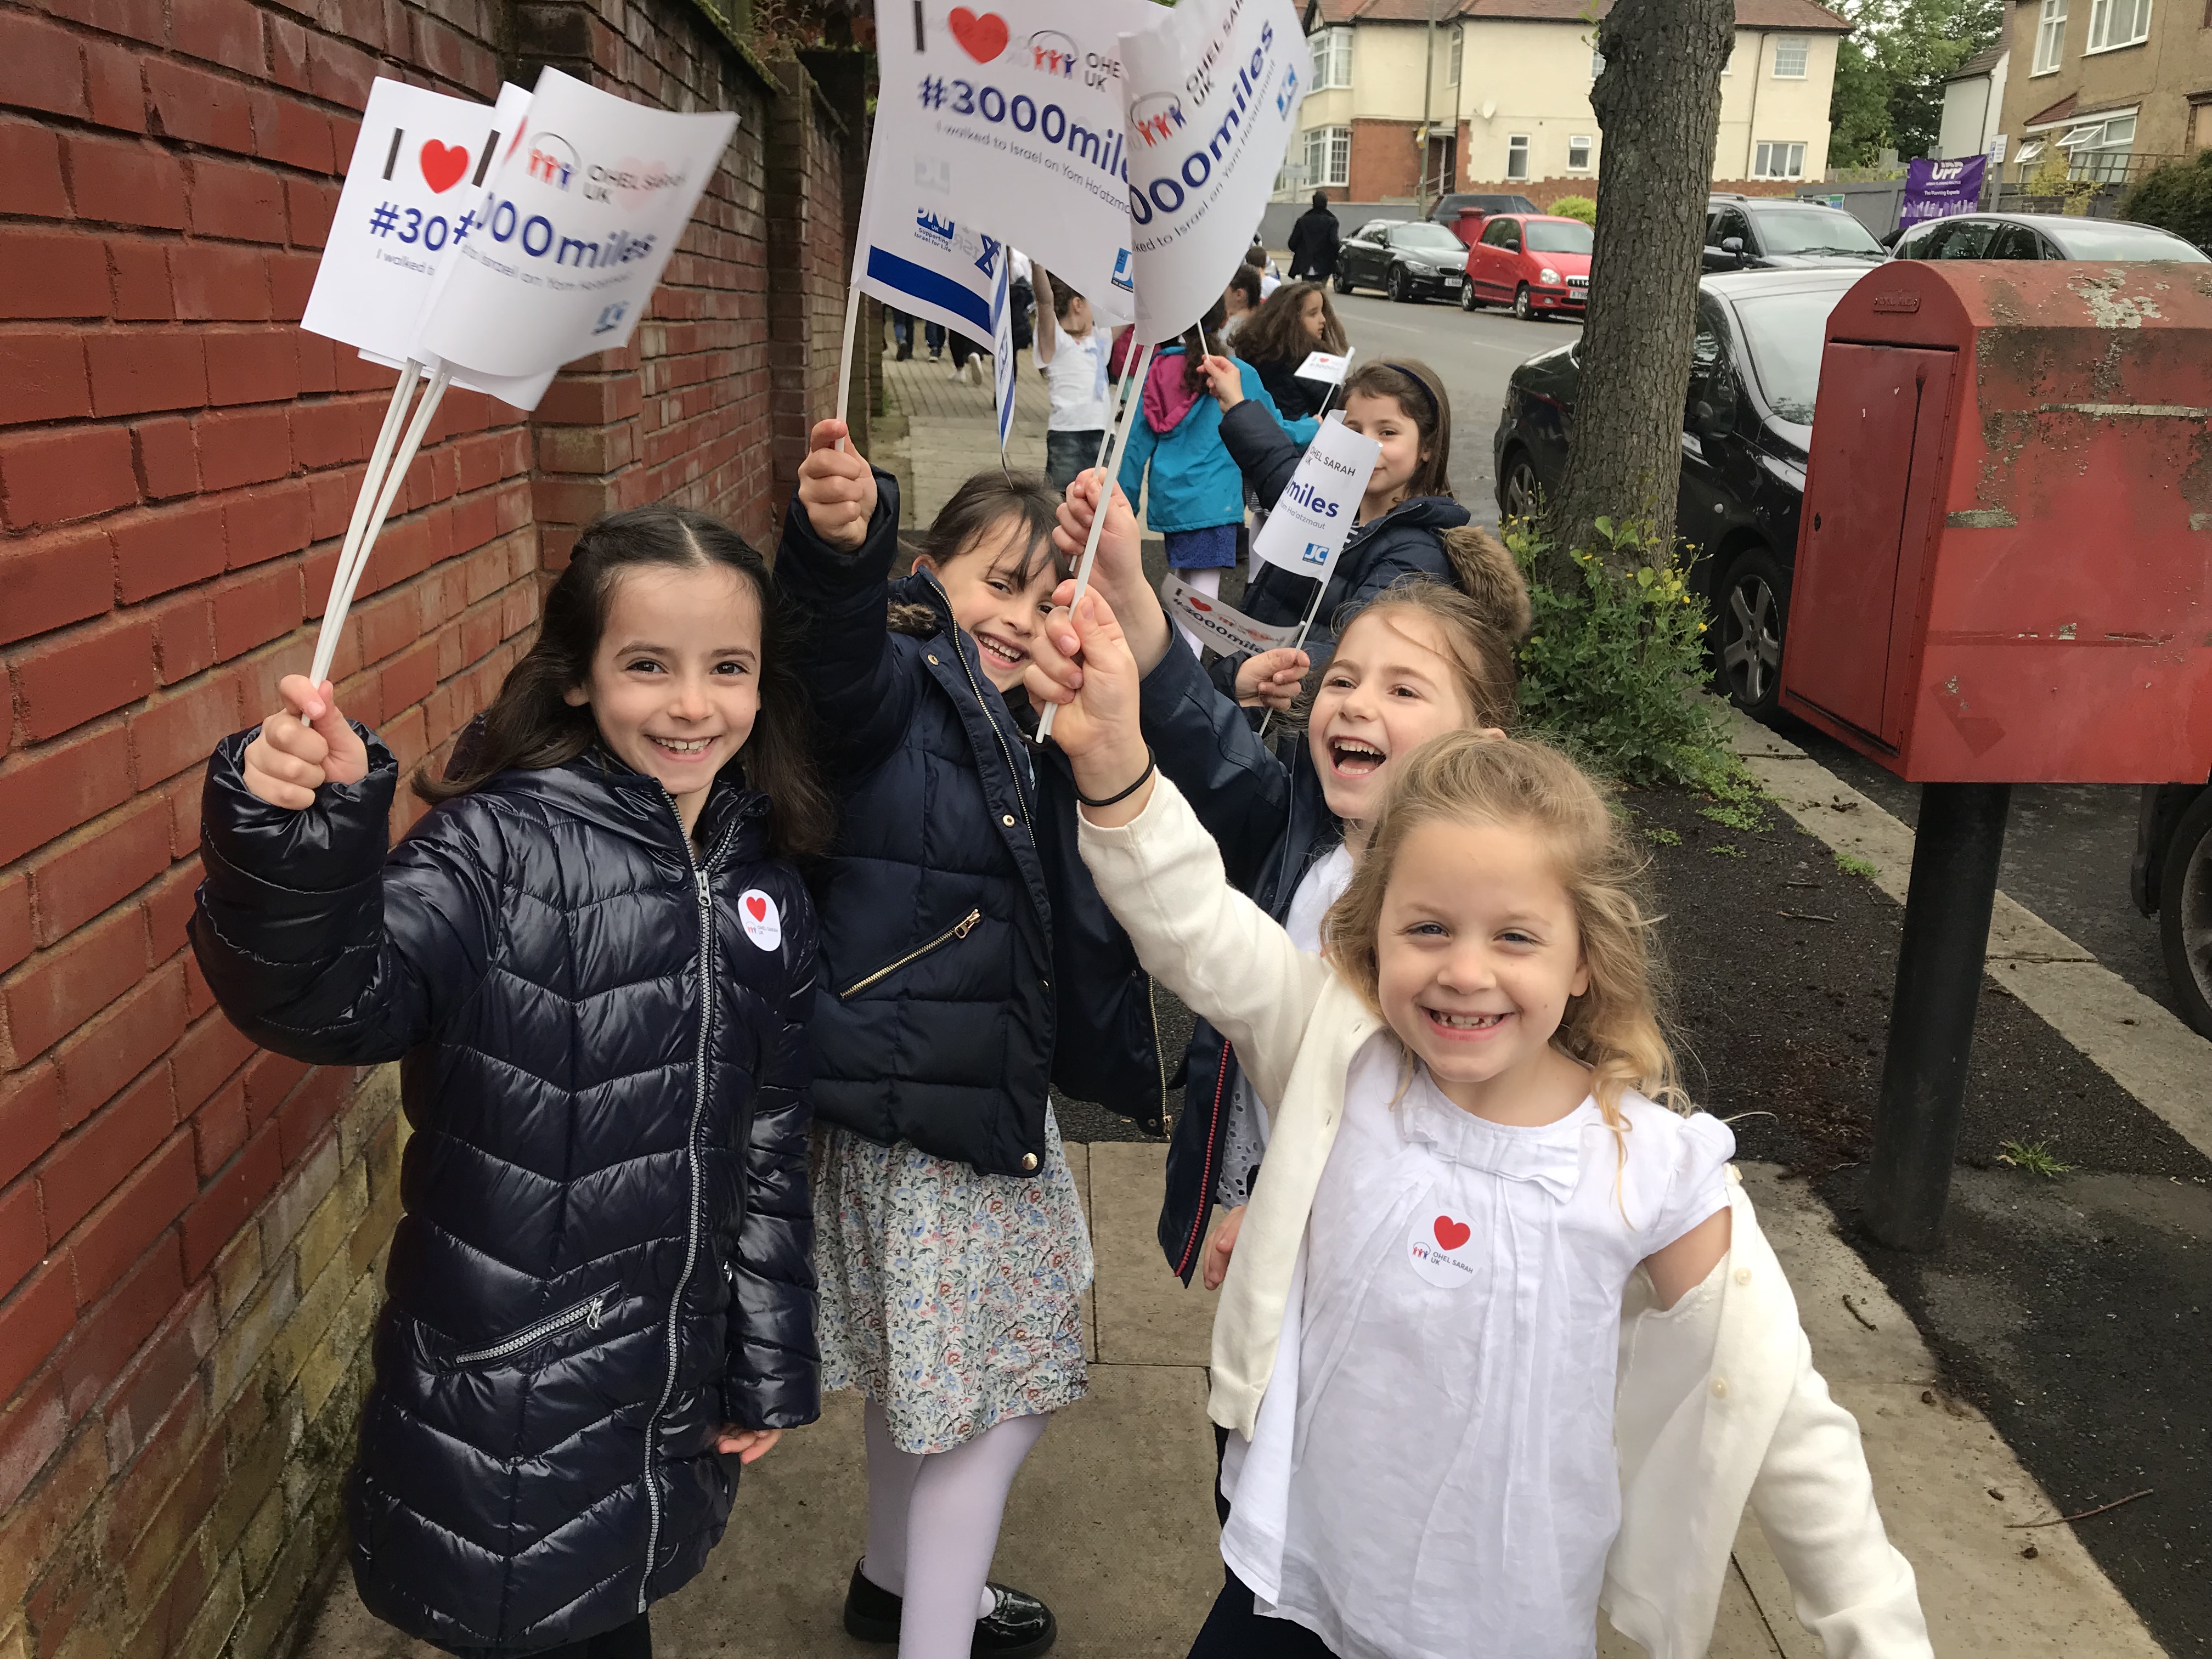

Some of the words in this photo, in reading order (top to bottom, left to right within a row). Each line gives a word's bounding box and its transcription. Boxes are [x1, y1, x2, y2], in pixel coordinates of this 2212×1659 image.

[1186, 39, 1224, 94] OHEL
[1084, 70, 1109, 93] UK
[1192, 76, 1215, 107] UK
[382, 127, 405, 182] I
[471, 128, 502, 189] I
[935, 120, 942, 133] I
[945, 125, 991, 146] walked
[994, 136, 1008, 151] to
[1010, 140, 1043, 165] Israel
[1044, 157, 1060, 173] on
[1062, 162, 1084, 186] Yom
[1932, 161, 1964, 180] UPP
[1156, 234, 1173, 248] to
[1174, 199, 1210, 238] Israel
[1209, 181, 1224, 203] on
[1221, 146, 1243, 179] Yom
[914, 232, 931, 243] Israel
[931, 239, 940, 247] for
[940, 244, 952, 253] Life
[918, 227, 949, 246] Supporting
[376, 248, 382, 259] I
[383, 251, 426, 274] walked
[1305, 454, 1314, 466] UK
[1310, 445, 1323, 462] OHEL
[1323, 456, 1356, 477] SARAH
[1286, 506, 1326, 530] Ha'atzmaut
[1304, 544, 1328, 562] JC
[1430, 1257, 1441, 1266] UK
[1432, 1251, 1451, 1264] OHEL
[1452, 1259, 1474, 1274] SARAH
